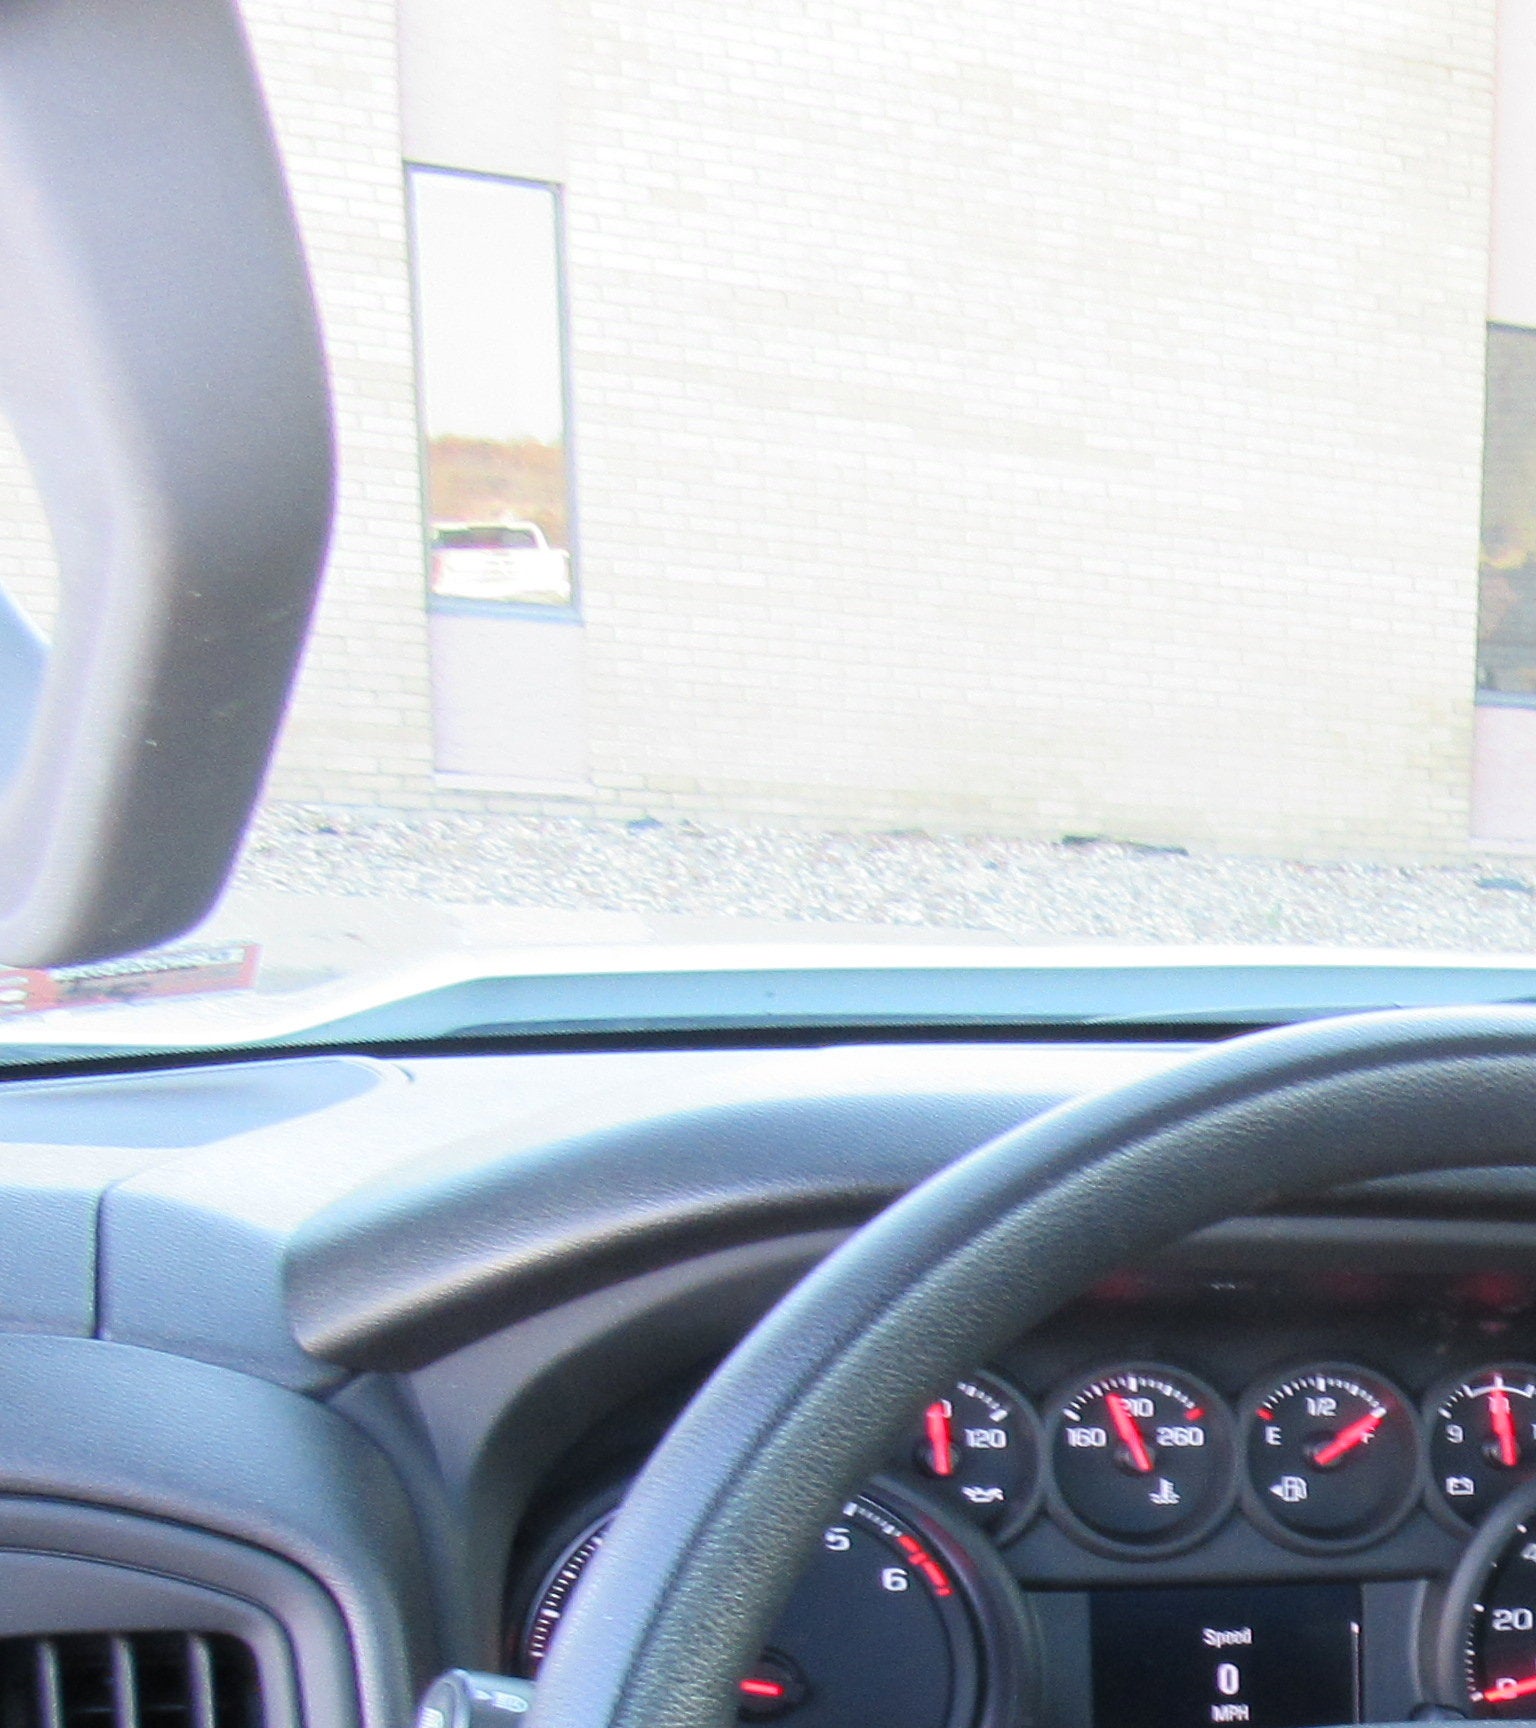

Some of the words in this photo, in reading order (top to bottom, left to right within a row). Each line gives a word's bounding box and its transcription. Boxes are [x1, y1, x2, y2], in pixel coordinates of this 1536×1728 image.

[1306, 1397, 1337, 1416] 1/2
[964, 1429, 1006, 1448] 120
[1066, 1428, 1106, 1447] 160
[1156, 1427, 1204, 1447] 260
[1265, 1427, 1282, 1445] E
[1446, 1425, 1464, 1444] 9
[825, 1529, 850, 1552] 5
[882, 1569, 908, 1592] 6
[1492, 1608, 1533, 1631] 20
[1202, 1627, 1252, 1648] Speed
[1217, 1662, 1239, 1695] 0
[1211, 1704, 1249, 1722] MPH
